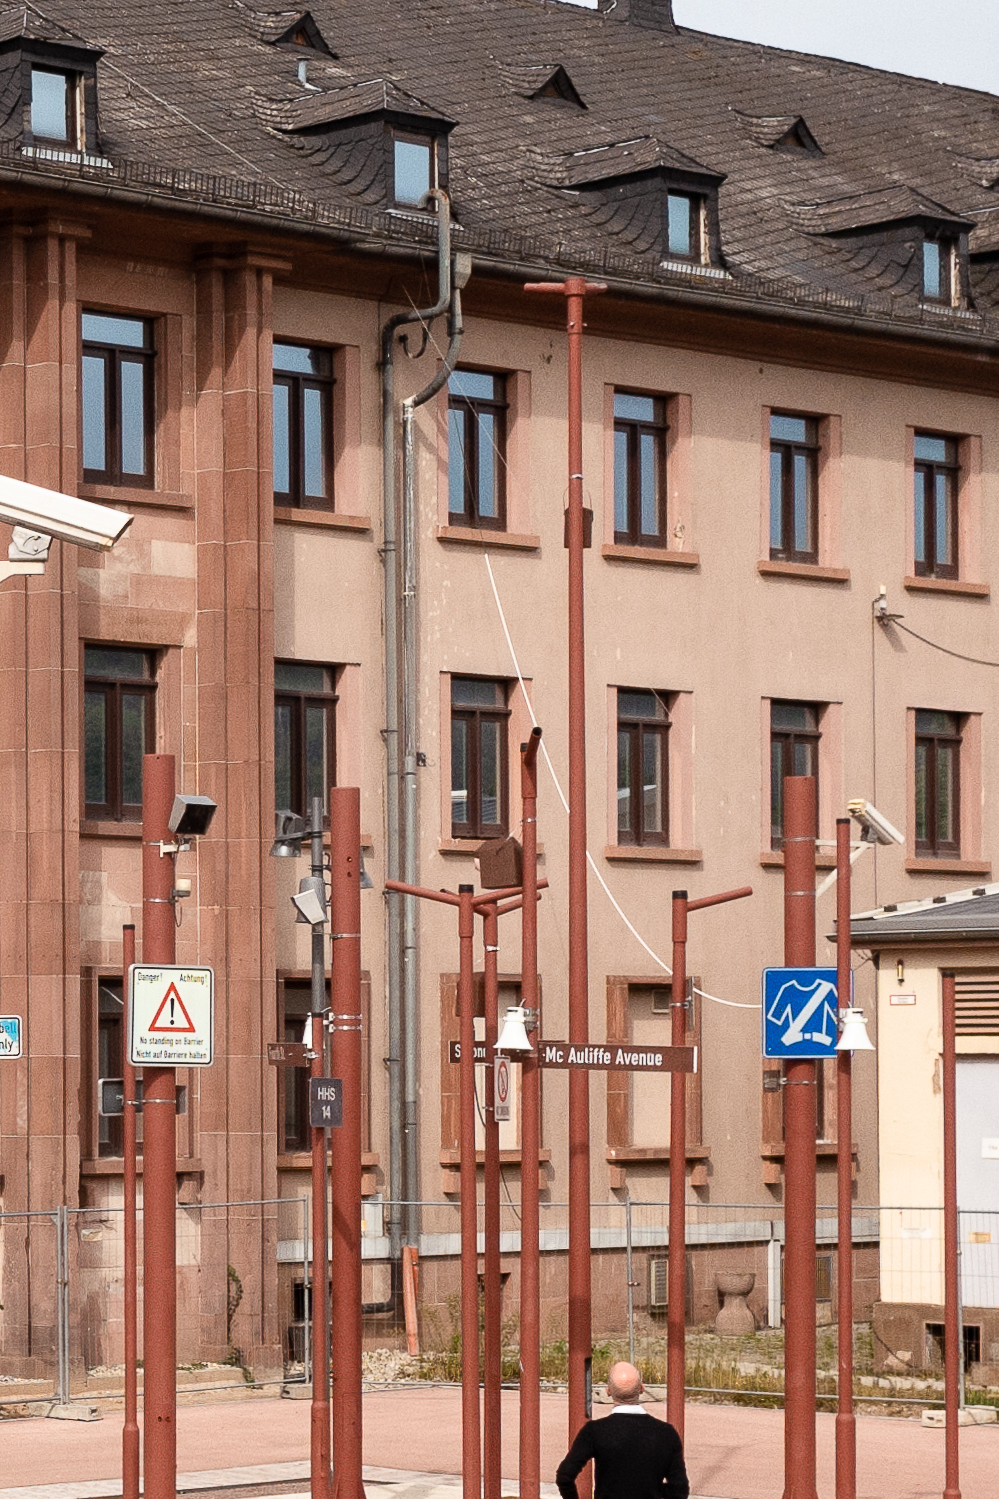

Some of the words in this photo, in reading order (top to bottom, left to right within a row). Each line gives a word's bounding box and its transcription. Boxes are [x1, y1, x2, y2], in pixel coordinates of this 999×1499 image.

[179, 974, 208, 986] Achtung!
[140, 1036, 147, 1045] No
[149, 1036, 173, 1047] standing
[184, 1036, 204, 1046] Barrier
[136, 1050, 151, 1059] Nicht
[152, 1050, 163, 1059] auf
[163, 1050, 188, 1059] Barriere
[189, 1051, 207, 1060] halten
[545, 1046, 564, 1063] Mc
[567, 1047, 612, 1065] Auliffe
[615, 1048, 663, 1066] Avenue
[317, 1087, 336, 1101] HHS
[321, 1105, 332, 1120] 14
